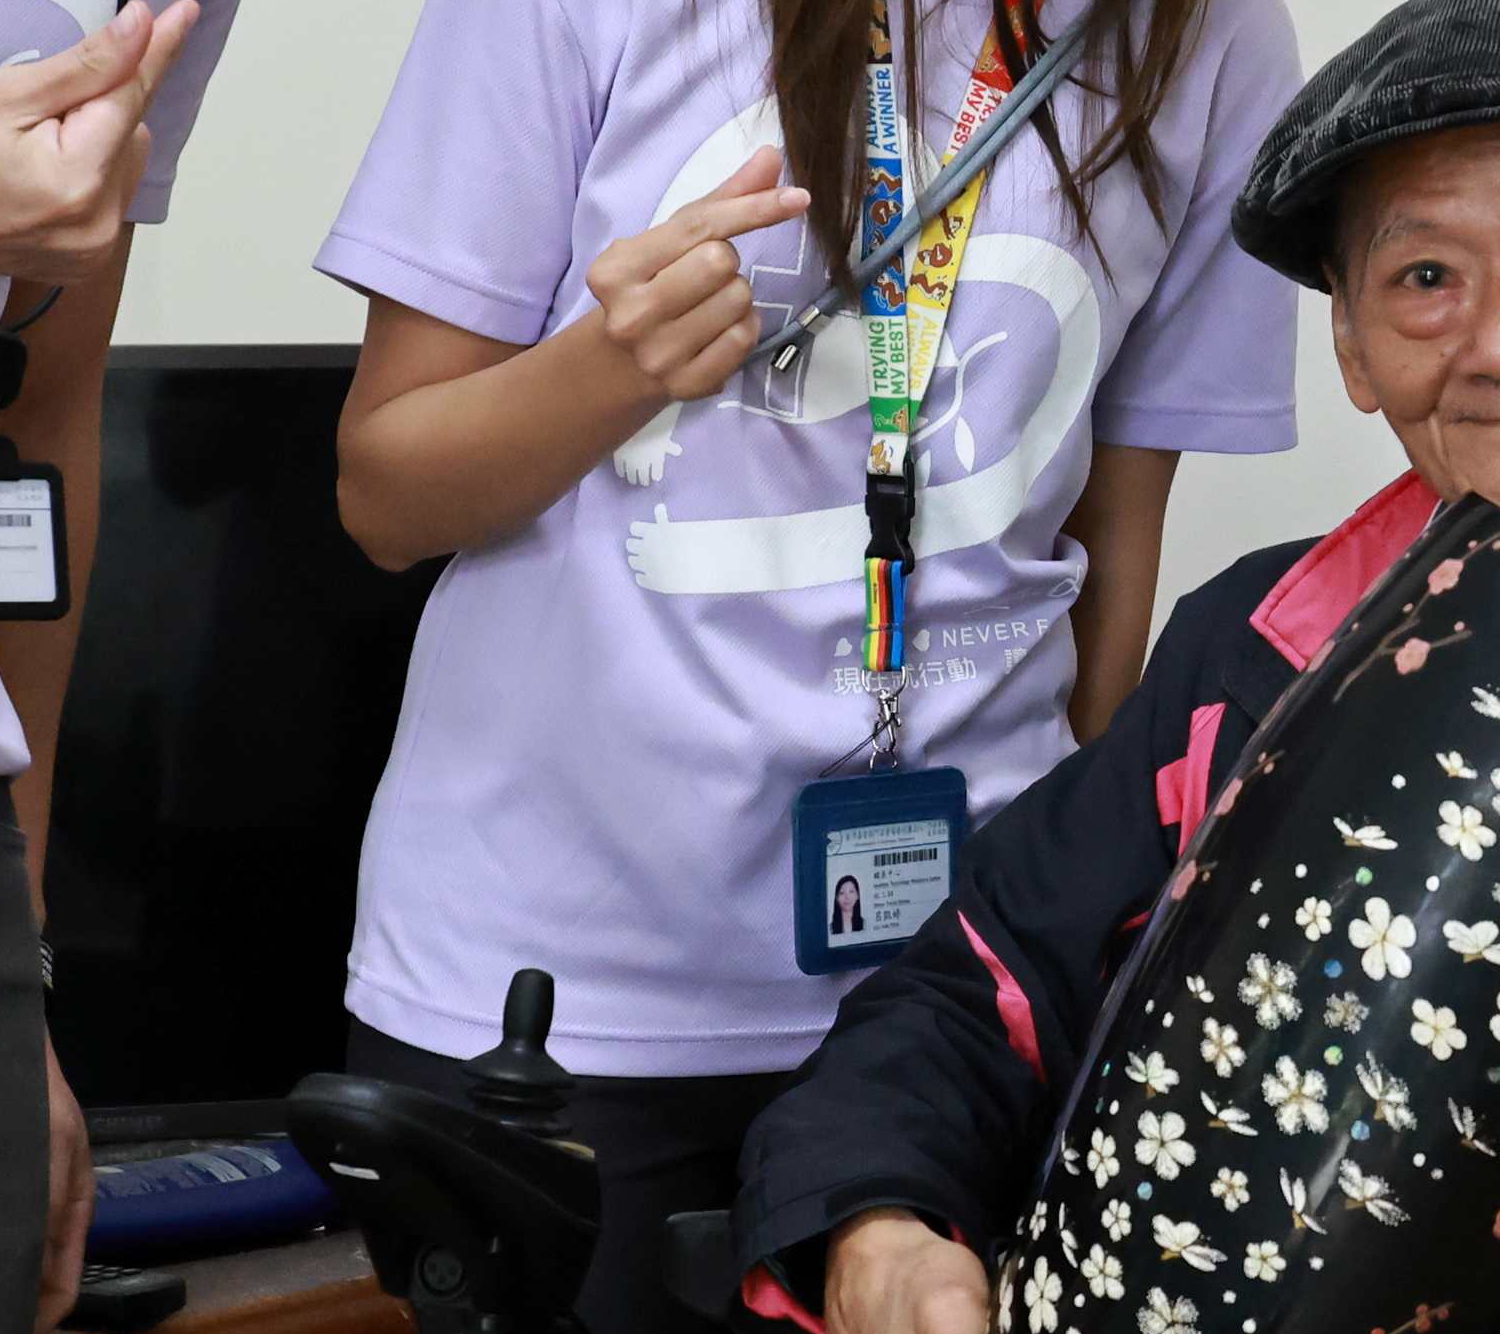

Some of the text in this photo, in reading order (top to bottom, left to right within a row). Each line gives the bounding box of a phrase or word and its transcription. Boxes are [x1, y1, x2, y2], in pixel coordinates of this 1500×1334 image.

[888, 318, 906, 395] MY BEST
[942, 620, 1029, 648] NEVER
